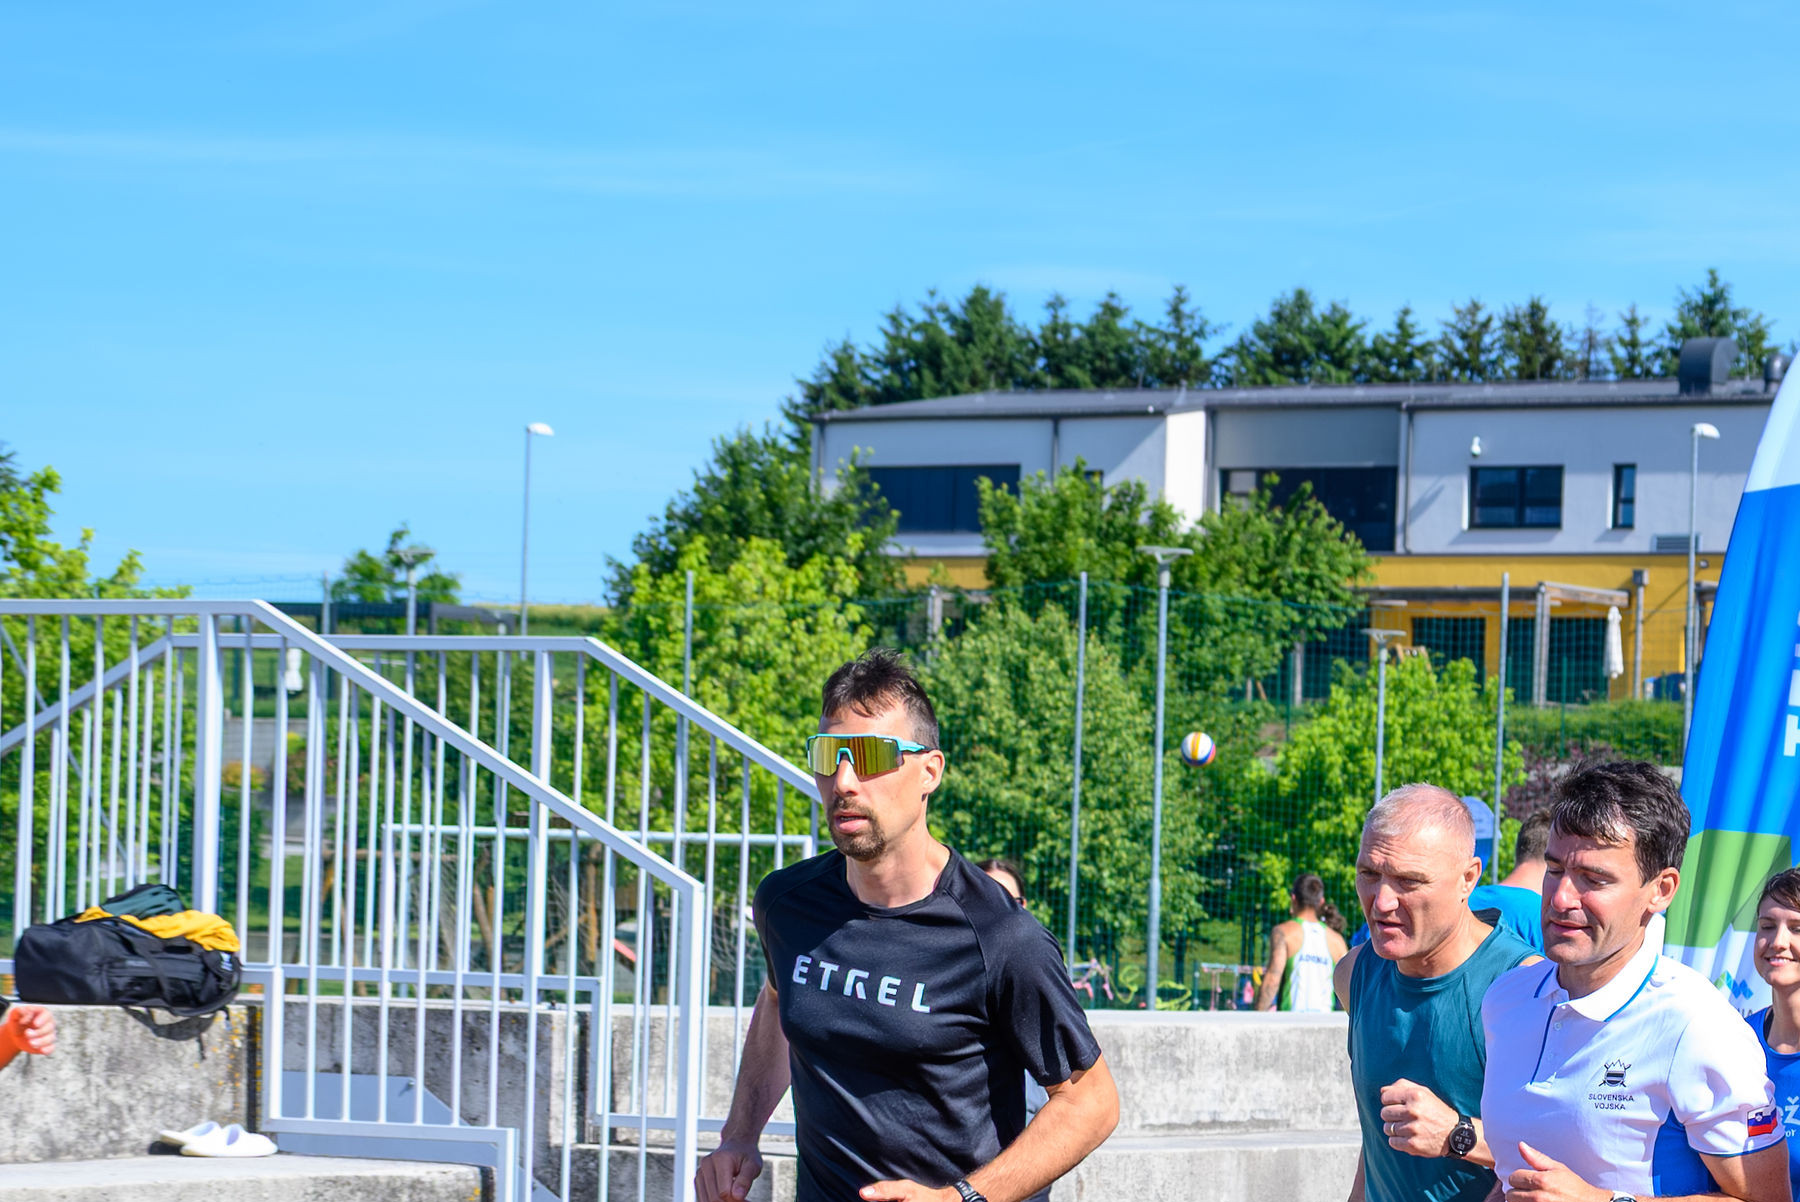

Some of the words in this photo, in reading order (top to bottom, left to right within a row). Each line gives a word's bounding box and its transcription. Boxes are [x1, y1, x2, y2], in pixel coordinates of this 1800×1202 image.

[791, 954, 932, 1014] ETREL
[1588, 1093, 1635, 1102] SLOVENSKA
[1594, 1102, 1626, 1110] VOJSKA
[1785, 1129, 1797, 1137] or
